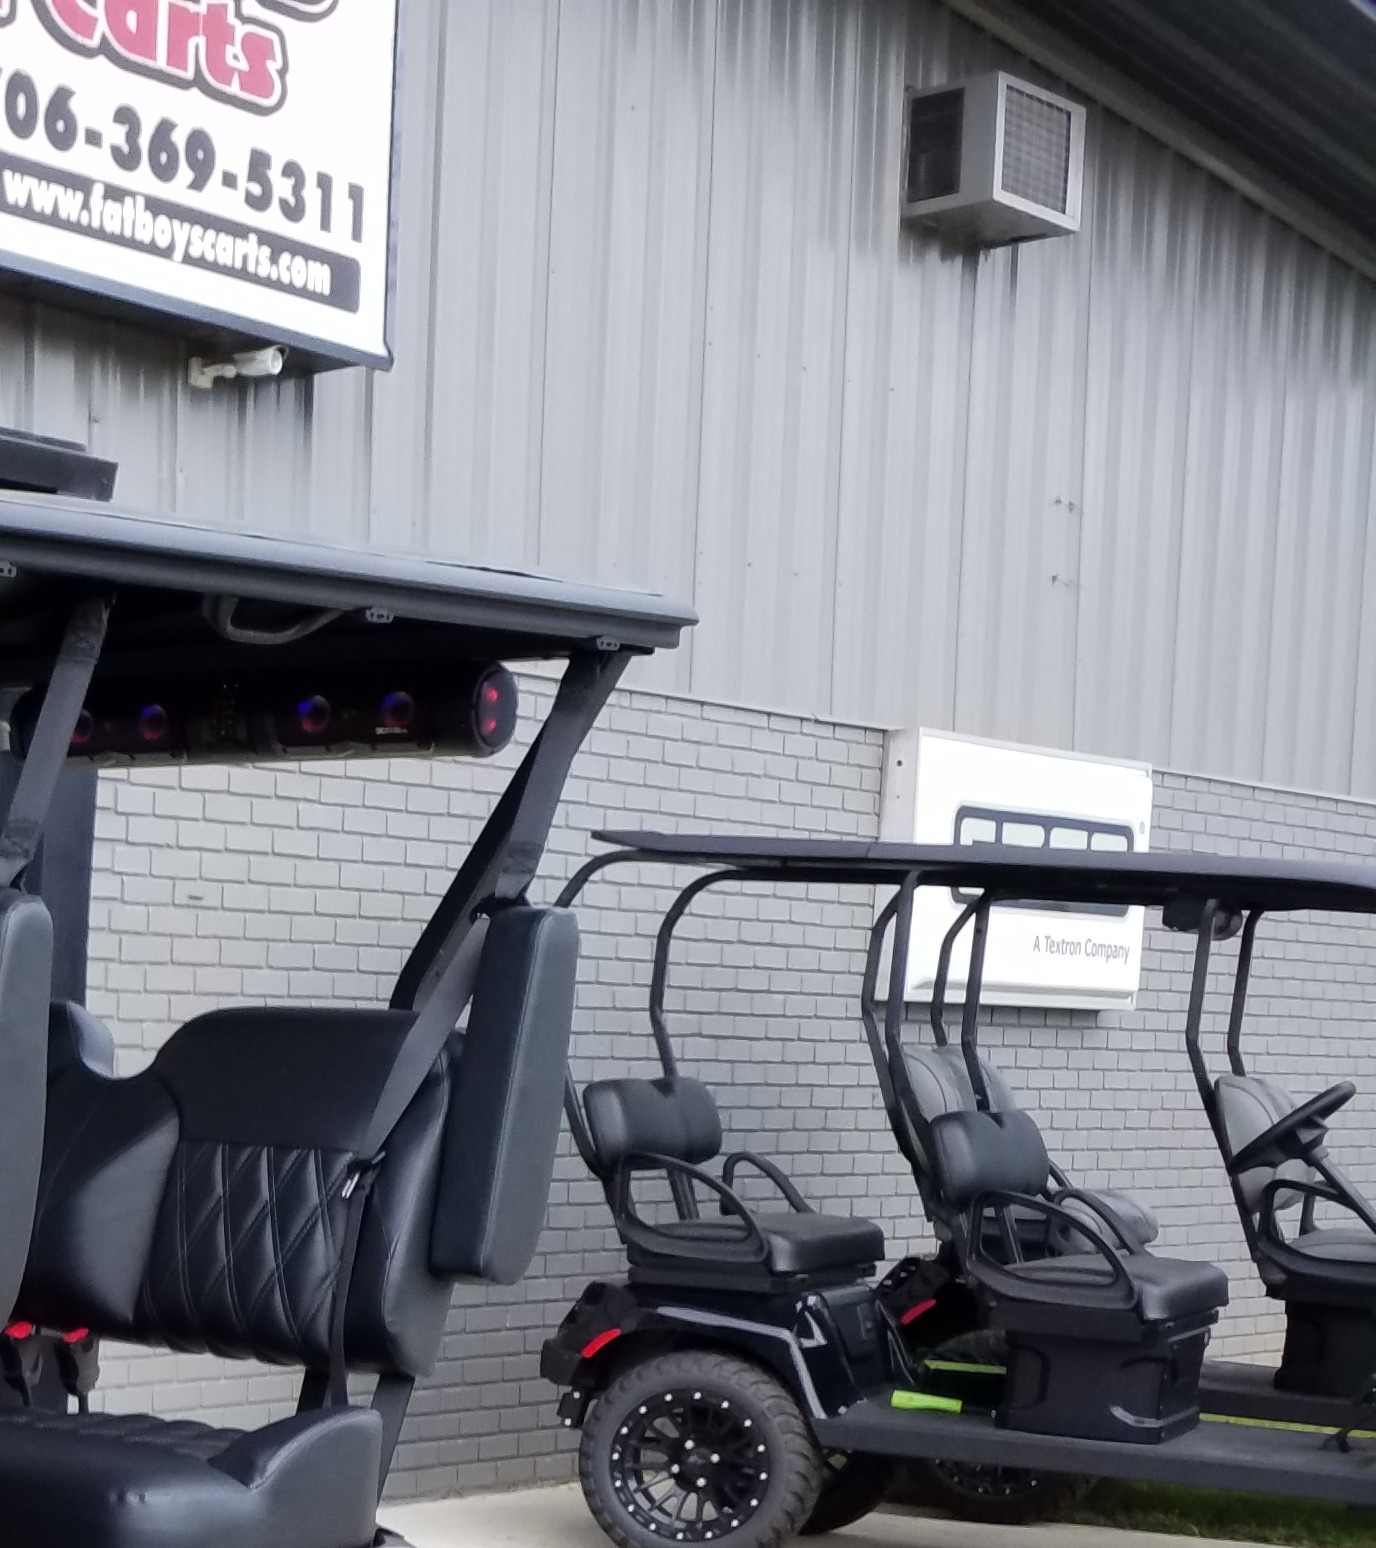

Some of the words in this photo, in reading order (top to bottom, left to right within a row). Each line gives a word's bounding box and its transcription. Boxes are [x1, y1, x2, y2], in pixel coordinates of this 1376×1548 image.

[2, 168, 332, 297] www.fatboyscarts.com
[1033, 935, 1040, 952] A
[1044, 935, 1081, 956] Textron
[1084, 938, 1129, 965] Company
